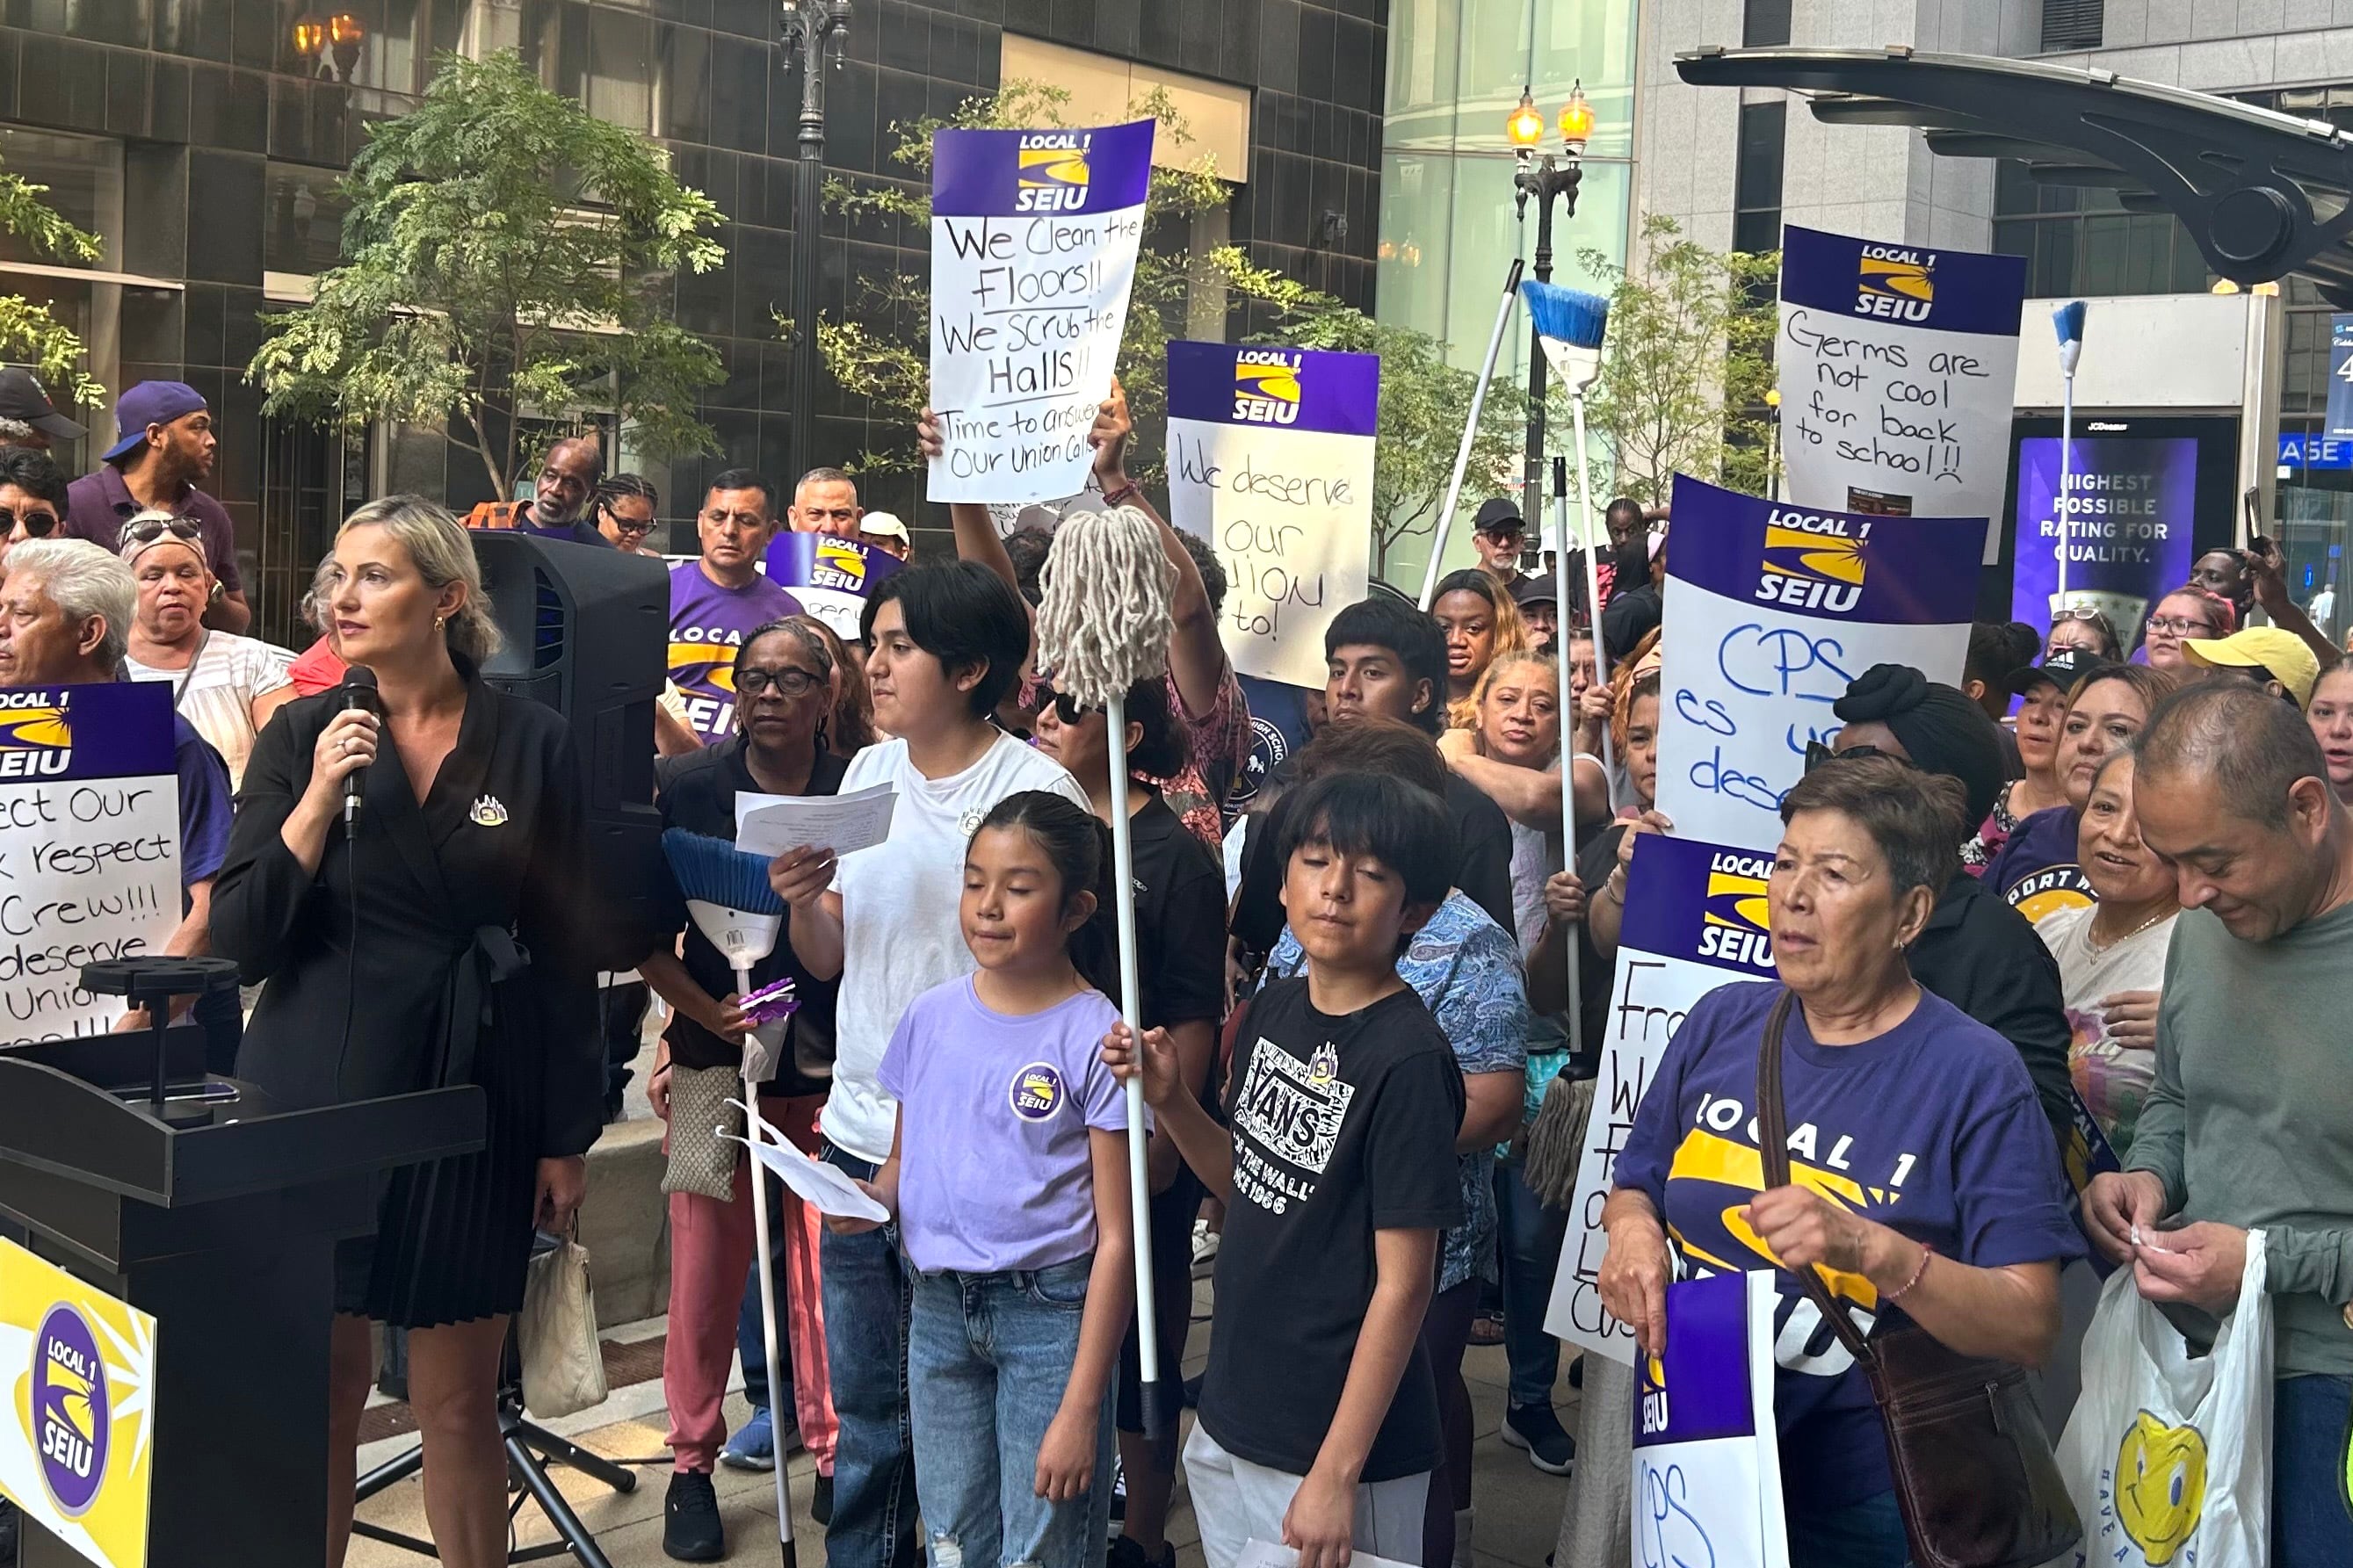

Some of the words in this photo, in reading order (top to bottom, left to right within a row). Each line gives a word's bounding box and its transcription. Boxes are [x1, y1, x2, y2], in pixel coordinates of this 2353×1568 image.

[1019, 134, 1077, 149] LOCAL
[1083, 134, 1090, 148] 1
[1016, 186, 1088, 211] SEIU
[945, 217, 1016, 260] We
[1026, 216, 1096, 255] Clean
[1104, 215, 1138, 246] the
[1862, 245, 1919, 264] LOCAL
[1927, 254, 1937, 266] 1
[972, 261, 1102, 307] Floors!!
[1855, 294, 1931, 322] SEIU
[940, 313, 997, 355] We
[1085, 310, 1114, 332] the
[1787, 310, 1908, 367] Germs
[1929, 353, 1989, 378] are
[1237, 350, 1287, 366] LOCAL
[1818, 362, 1868, 392] not
[1887, 380, 1948, 408] cool
[936, 409, 1002, 440] Time
[1008, 410, 1037, 436] to
[1233, 400, 1299, 424] SEIU
[1809, 391, 1857, 427] for
[1881, 404, 1957, 443] back
[1797, 417, 1821, 444] to
[952, 448, 1003, 478] Our
[1012, 442, 1061, 473] Union
[2277, 441, 2339, 461] ASE
[1177, 433, 1220, 488] We
[1233, 454, 1353, 506] deserve
[2060, 474, 2151, 490] HIGHEST
[2053, 498, 2155, 515] POSSIBLE
[1768, 509, 1848, 538] LOCAL
[1859, 523, 1872, 538] 1
[2126, 524, 2167, 539] FOR
[819, 537, 858, 553] LOCAL
[810, 571, 864, 591] SEIU
[1756, 574, 1862, 611] SEIU
[670, 627, 742, 646] LOCA
[1232, 600, 1277, 642] to!
[1719, 624, 1856, 702] CPS
[0, 692, 50, 708] OCAL
[60, 691, 69, 706] 1
[0, 749, 71, 777] EIU
[69, 787, 152, 822] Our
[33, 834, 171, 874] respect
[1711, 853, 1775, 879] LOCAL
[2008, 871, 2071, 905] PORT
[1, 884, 159, 935] Crew!!!
[1698, 926, 1776, 967] SEIU
[5, 981, 117, 1020] Unio
[1025, 1073, 1049, 1082] LOCAL
[1017, 1095, 1052, 1110] SEIU
[1247, 1058, 1329, 1147] VANS
[1696, 1093, 1850, 1169] LOAL
[1889, 1152, 1916, 1187] 1
[1242, 1147, 1263, 1176] THE
[1249, 1181, 1287, 1214] 1966
[48, 1336, 85, 1376] LOCAL
[90, 1361, 96, 1381] 1
[1643, 1391, 1669, 1434] SEIU
[43, 1423, 92, 1478] SEIU
